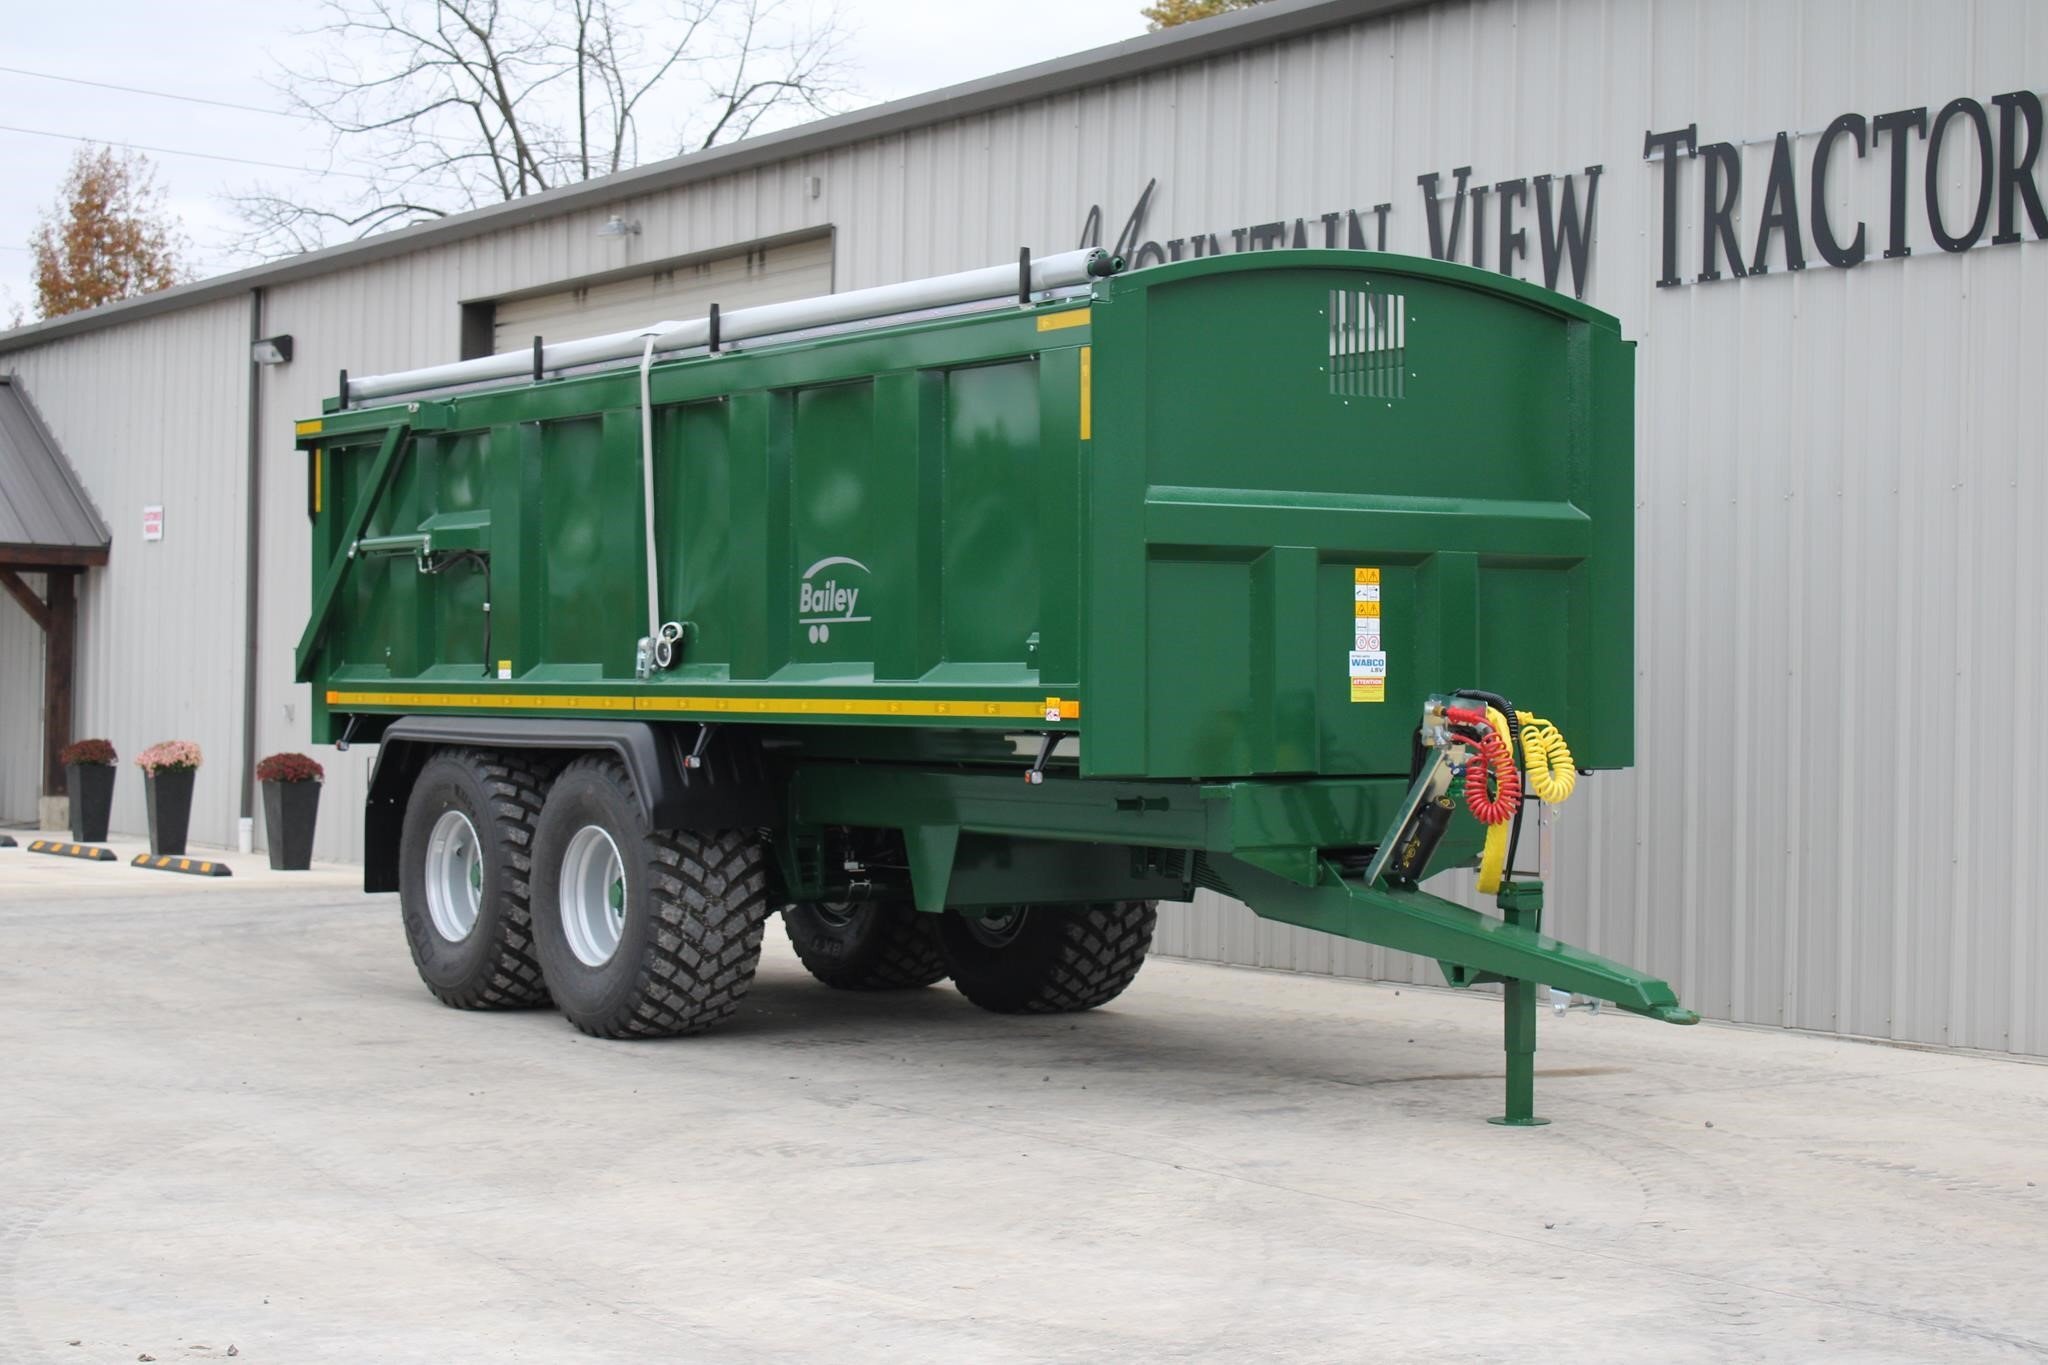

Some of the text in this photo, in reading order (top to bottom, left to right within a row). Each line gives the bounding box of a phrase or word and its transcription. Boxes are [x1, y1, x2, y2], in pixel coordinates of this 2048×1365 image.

[1417, 164, 1603, 300] VIEW
[1643, 90, 2048, 288] TRACTOR
[800, 580, 859, 618] Bailey
